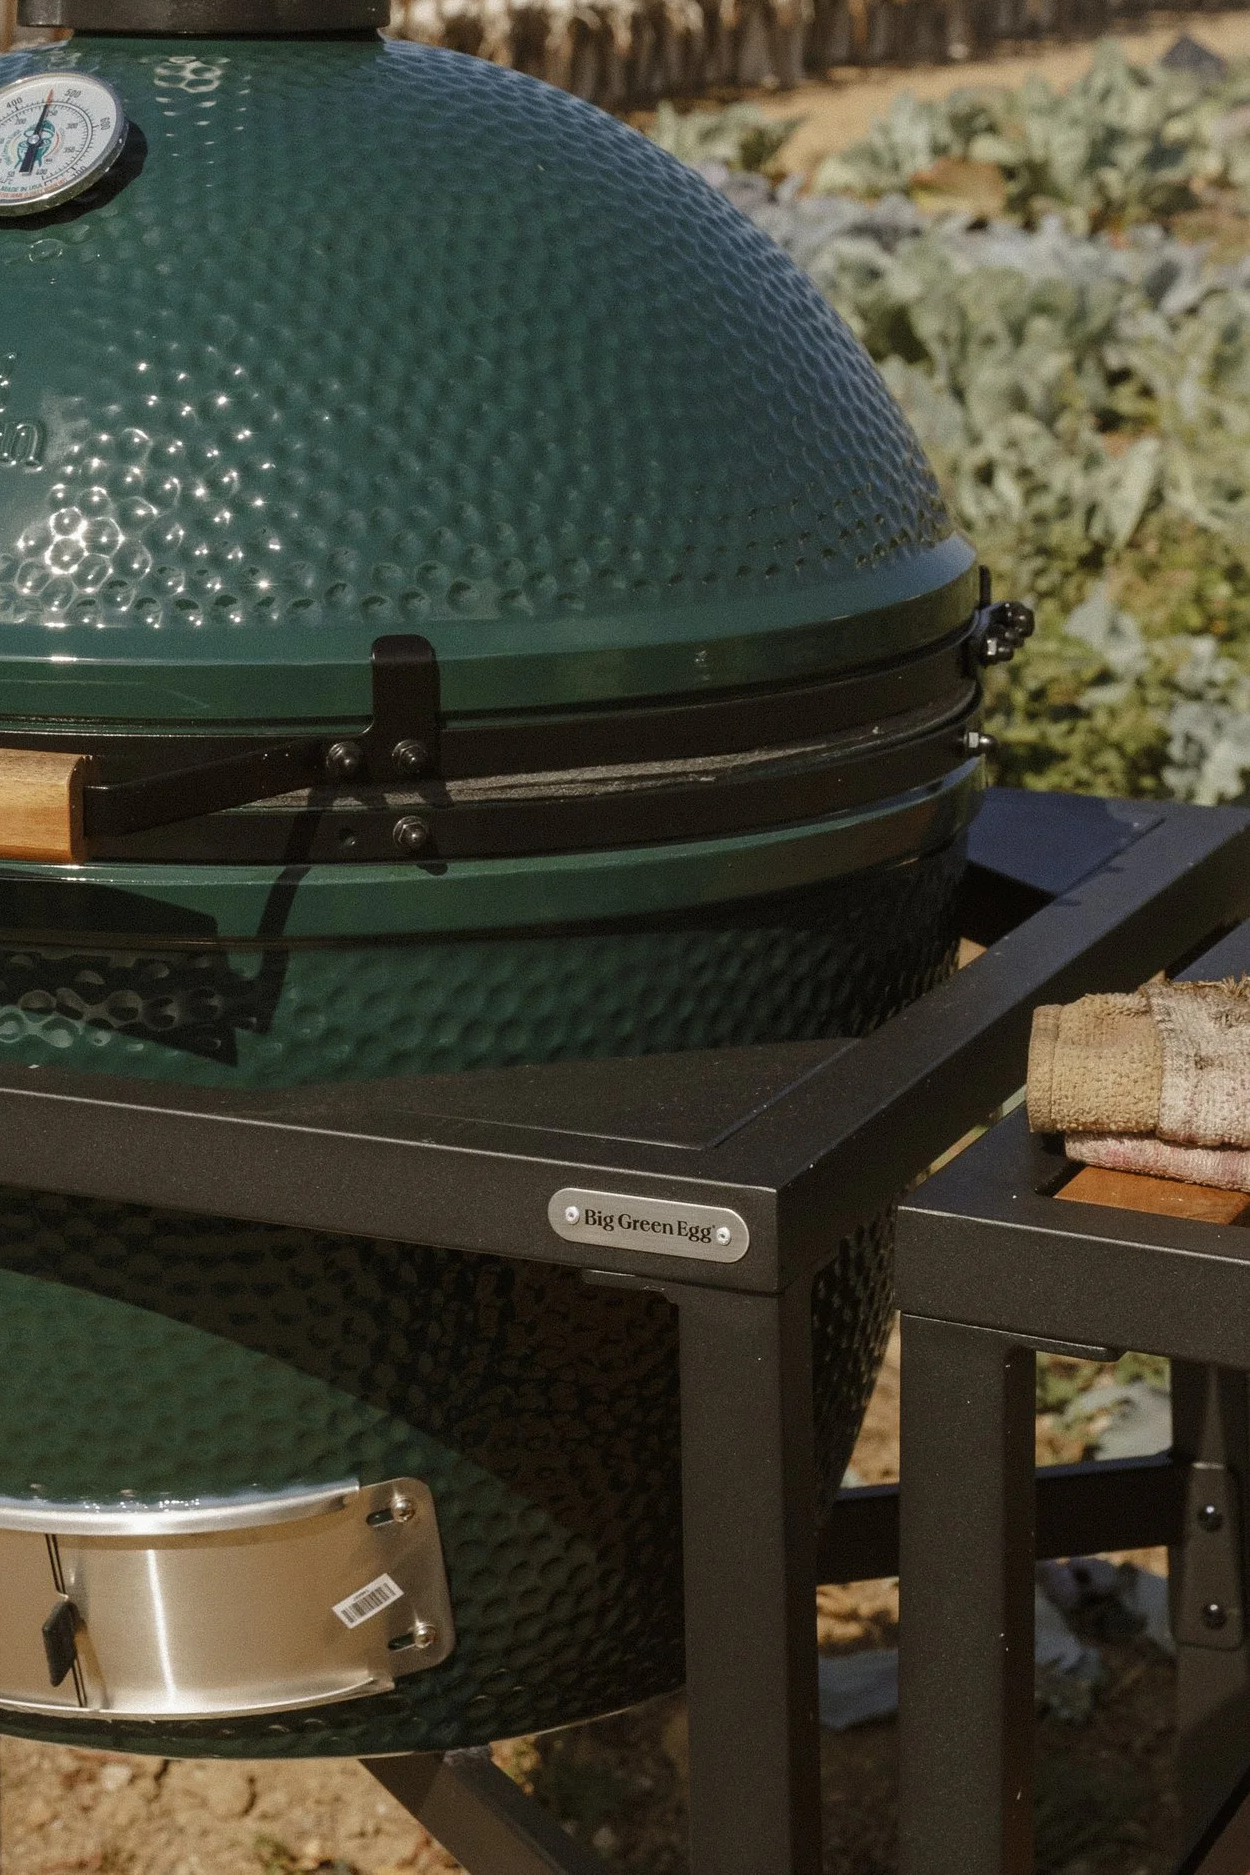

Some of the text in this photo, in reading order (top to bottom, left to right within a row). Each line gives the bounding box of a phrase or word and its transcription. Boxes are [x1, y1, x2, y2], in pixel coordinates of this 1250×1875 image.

[64, 88, 82, 98] 500
[6, 96, 23, 108] 400
[584, 1208, 614, 1232] Big
[618, 1213, 674, 1235] Green
